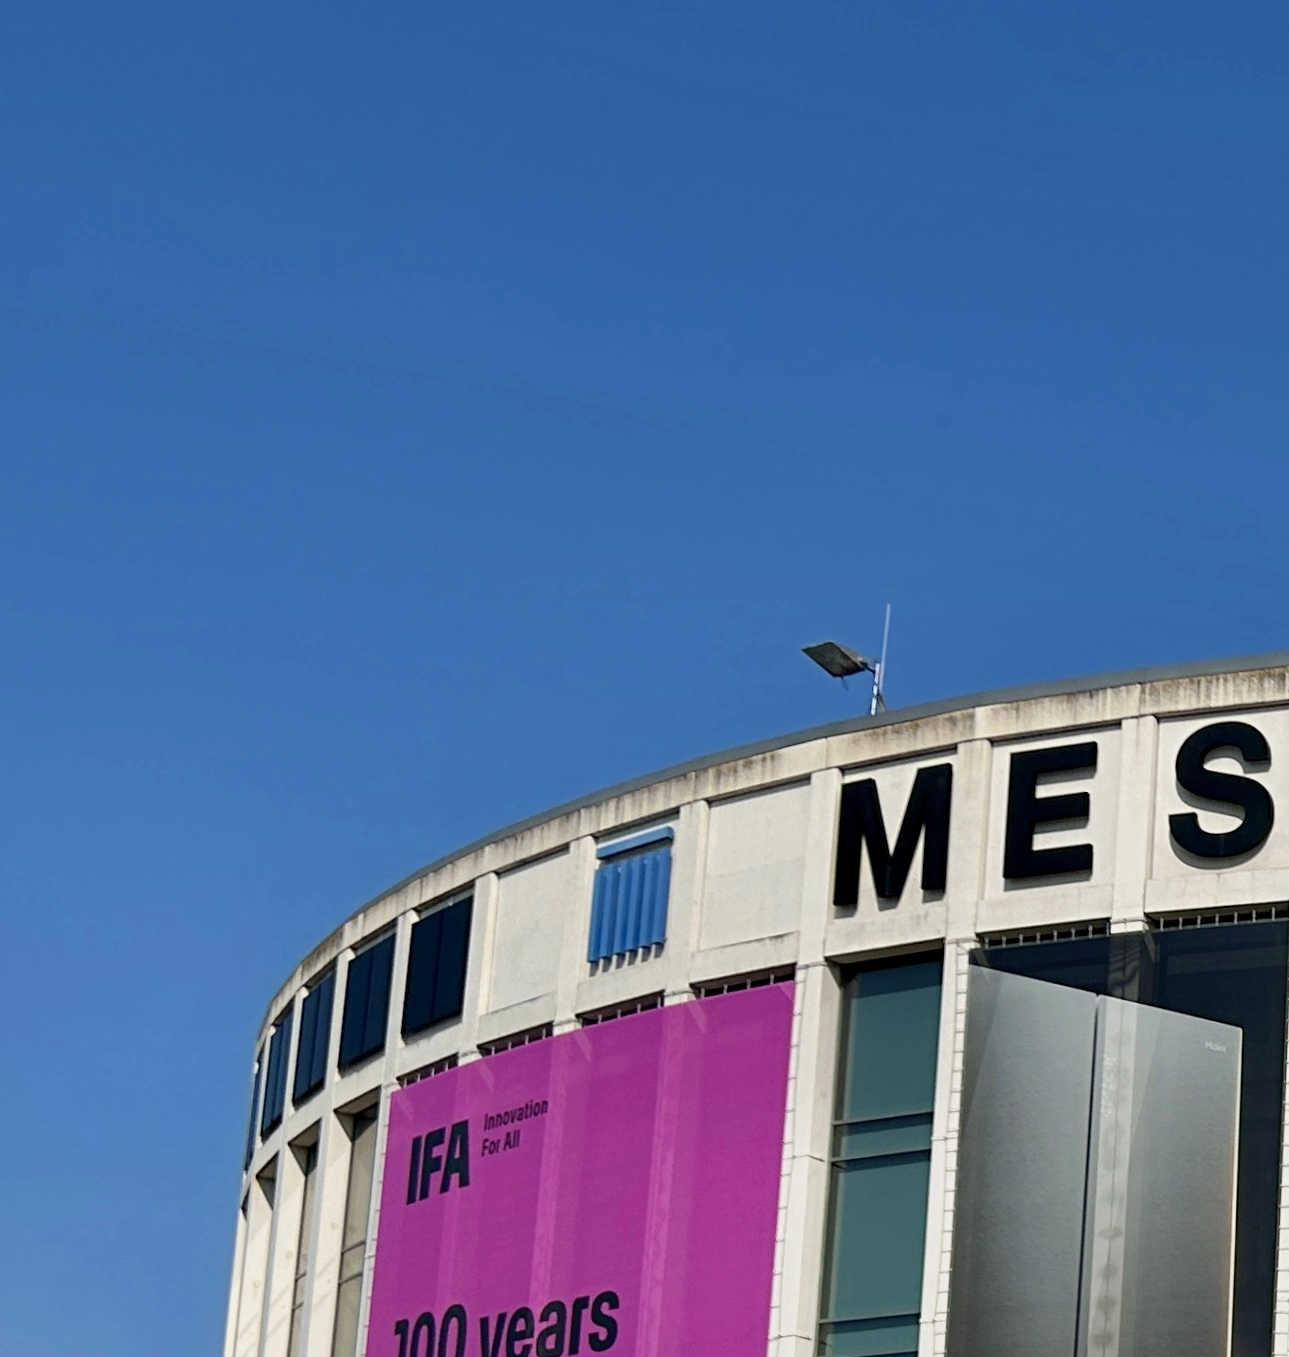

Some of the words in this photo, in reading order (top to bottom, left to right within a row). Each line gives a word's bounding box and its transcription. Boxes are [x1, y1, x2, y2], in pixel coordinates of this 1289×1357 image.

[483, 1100, 549, 1131] Innovation
[481, 1138, 501, 1157] For
[504, 1129, 521, 1151] All
[406, 1119, 470, 1206] IFA
